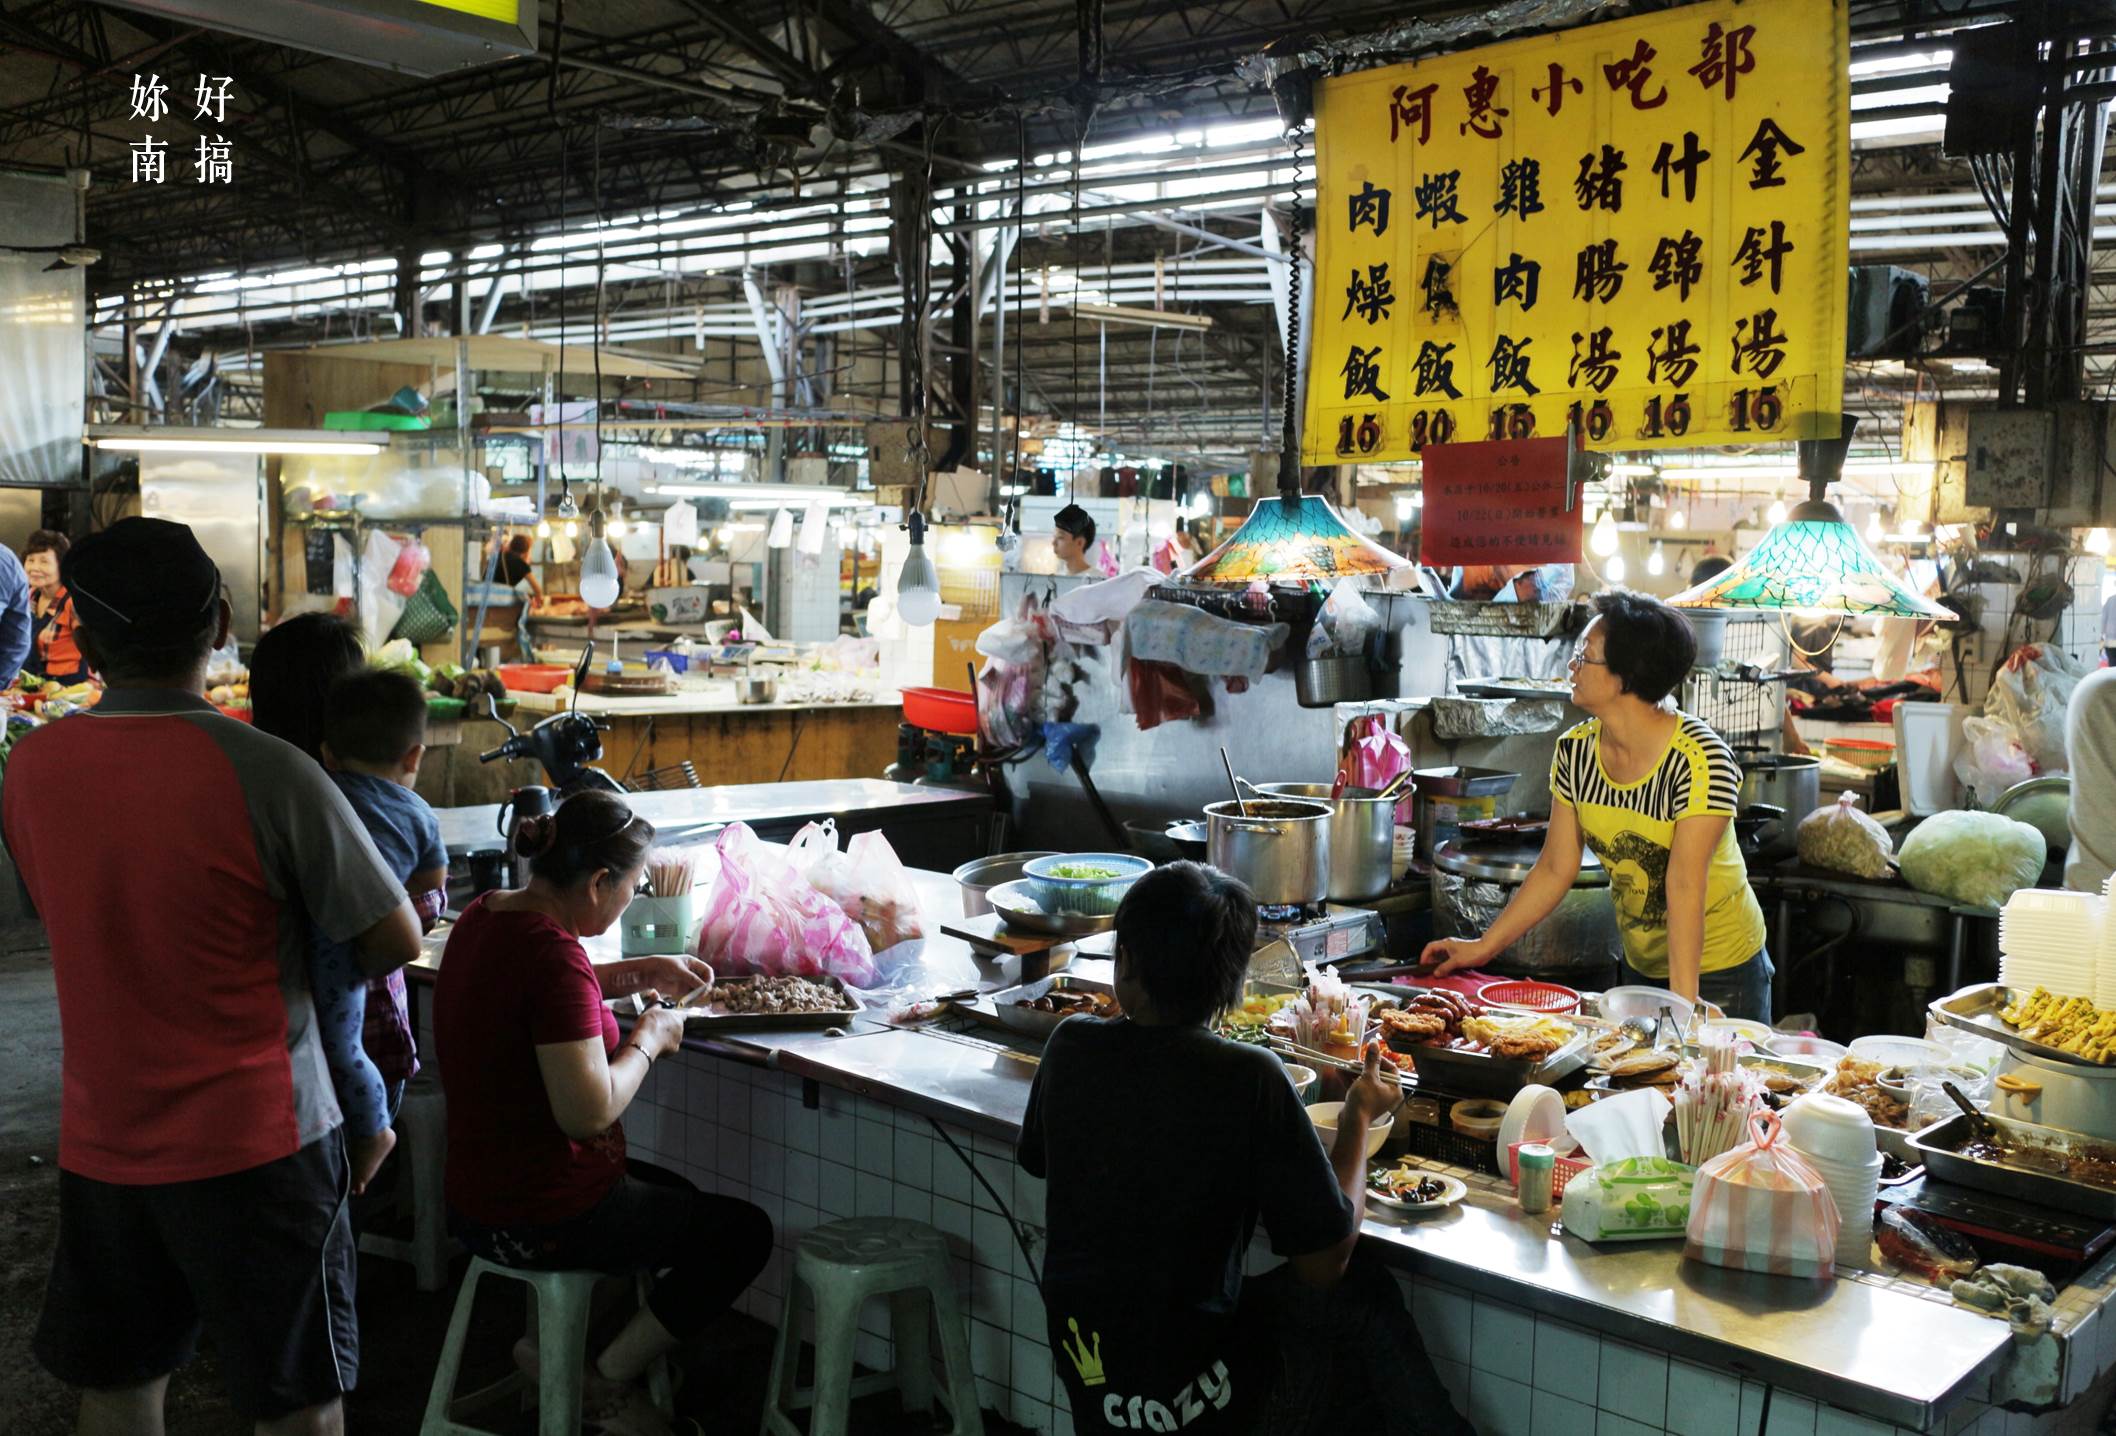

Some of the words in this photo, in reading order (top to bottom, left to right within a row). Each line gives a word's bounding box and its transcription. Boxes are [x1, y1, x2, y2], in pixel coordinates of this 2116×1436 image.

[1389, 22, 1757, 146] 阿惠小吃部
[1339, 180, 1396, 403] 肉燥飯
[1485, 156, 1545, 398] 雞肉飯
[1567, 143, 1630, 394] 豬腸湯
[1646, 130, 1712, 389] 什錦湯
[1730, 117, 1806, 380] 金針湯
[1645, 393, 1692, 437] 15
[1731, 386, 1782, 431] 15
[1103, 1359, 1232, 1433] crazy
